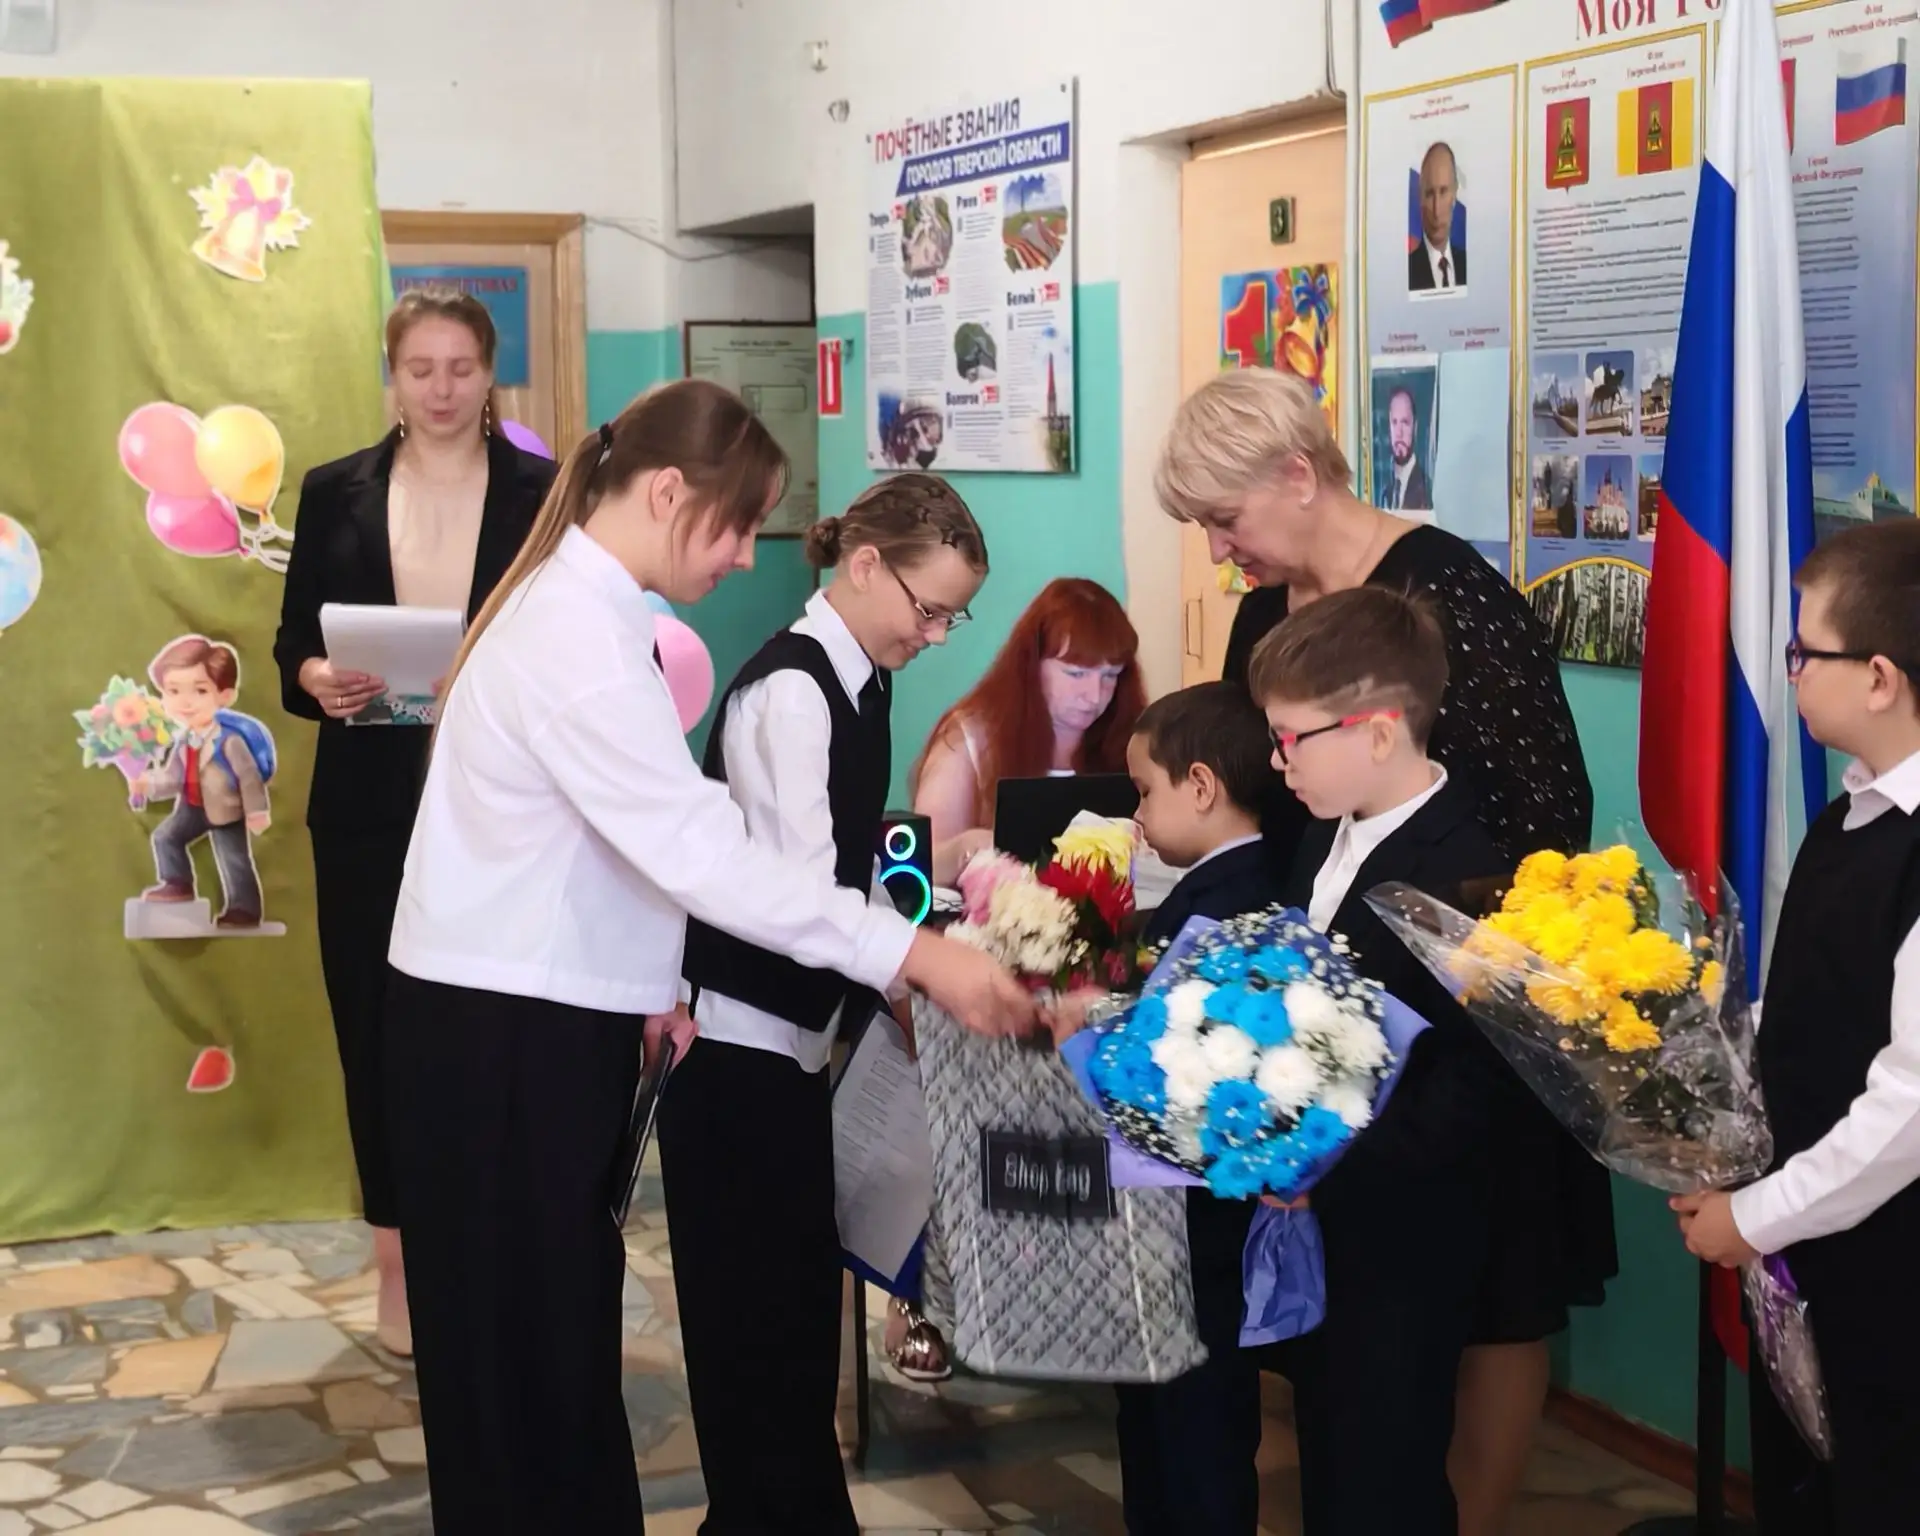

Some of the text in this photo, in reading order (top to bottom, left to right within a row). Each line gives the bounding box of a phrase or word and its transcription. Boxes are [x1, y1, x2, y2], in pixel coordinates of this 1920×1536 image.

[875, 98, 1020, 163] ПОЧЁТНЫЕ ЗВАНИЯ
[906, 131, 1062, 187] ГОРОДОВ ТВЕРСКОЙ ОБЛАСТИ
[1273, 204, 1285, 236] 3
